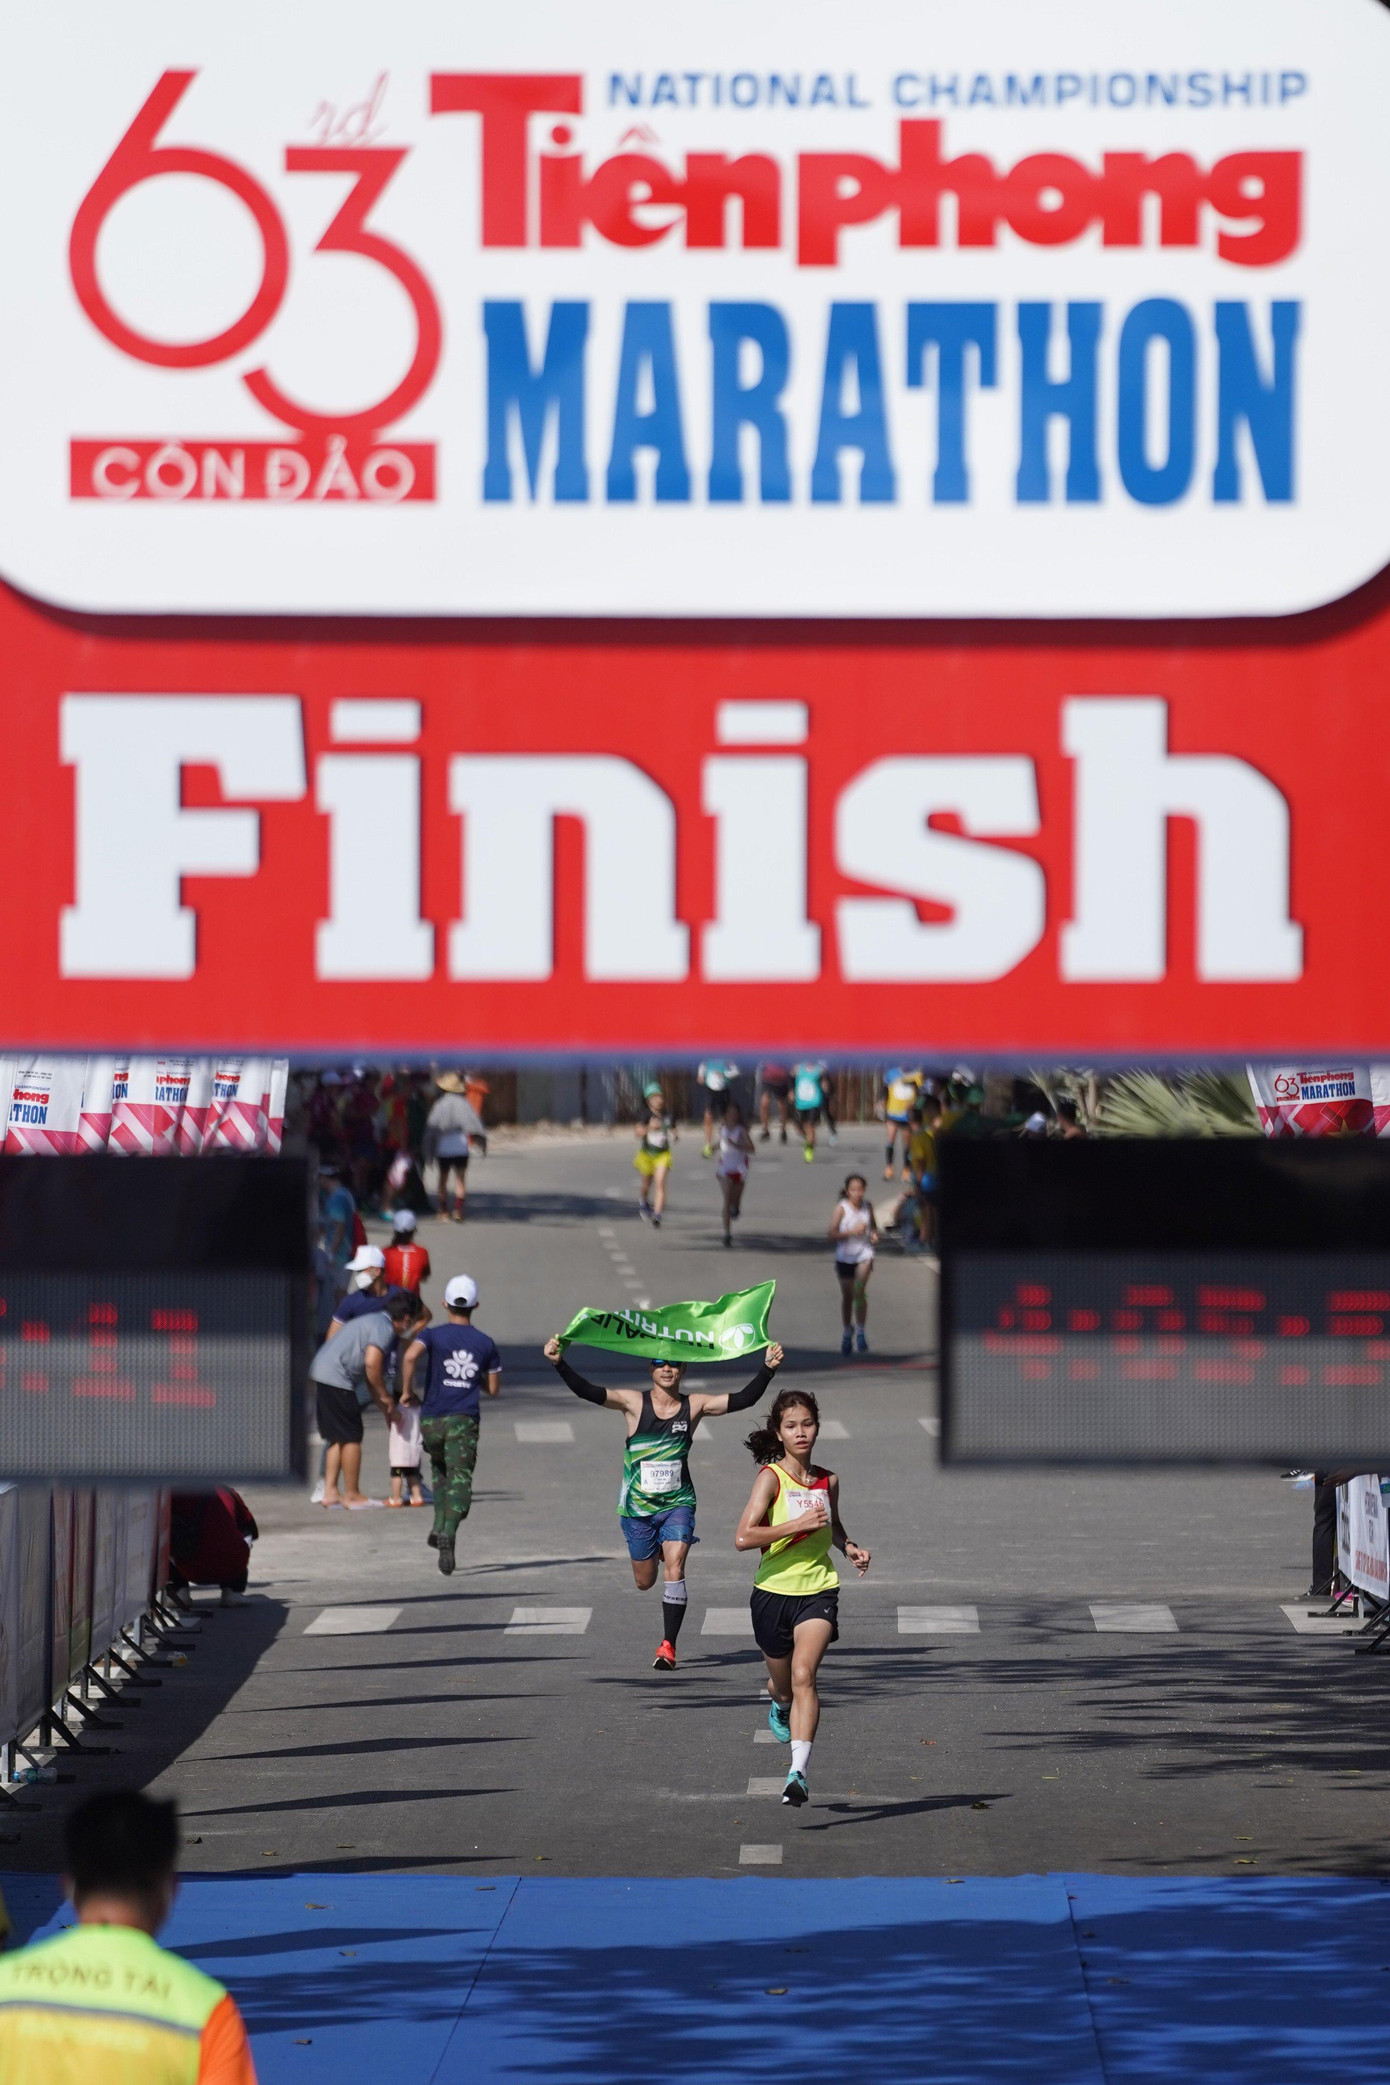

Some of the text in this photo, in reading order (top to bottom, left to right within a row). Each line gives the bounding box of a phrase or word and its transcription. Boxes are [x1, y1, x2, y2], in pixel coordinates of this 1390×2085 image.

[608, 73, 1309, 107] NATIONAL CHAMPIONSHIP
[482, 300, 1304, 507] MARATHON
[91, 440, 246, 502] CÔN
[59, 693, 1303, 984] Finish
[9, 1103, 48, 1124] THON
[1301, 1081, 1355, 1100] MARATHON
